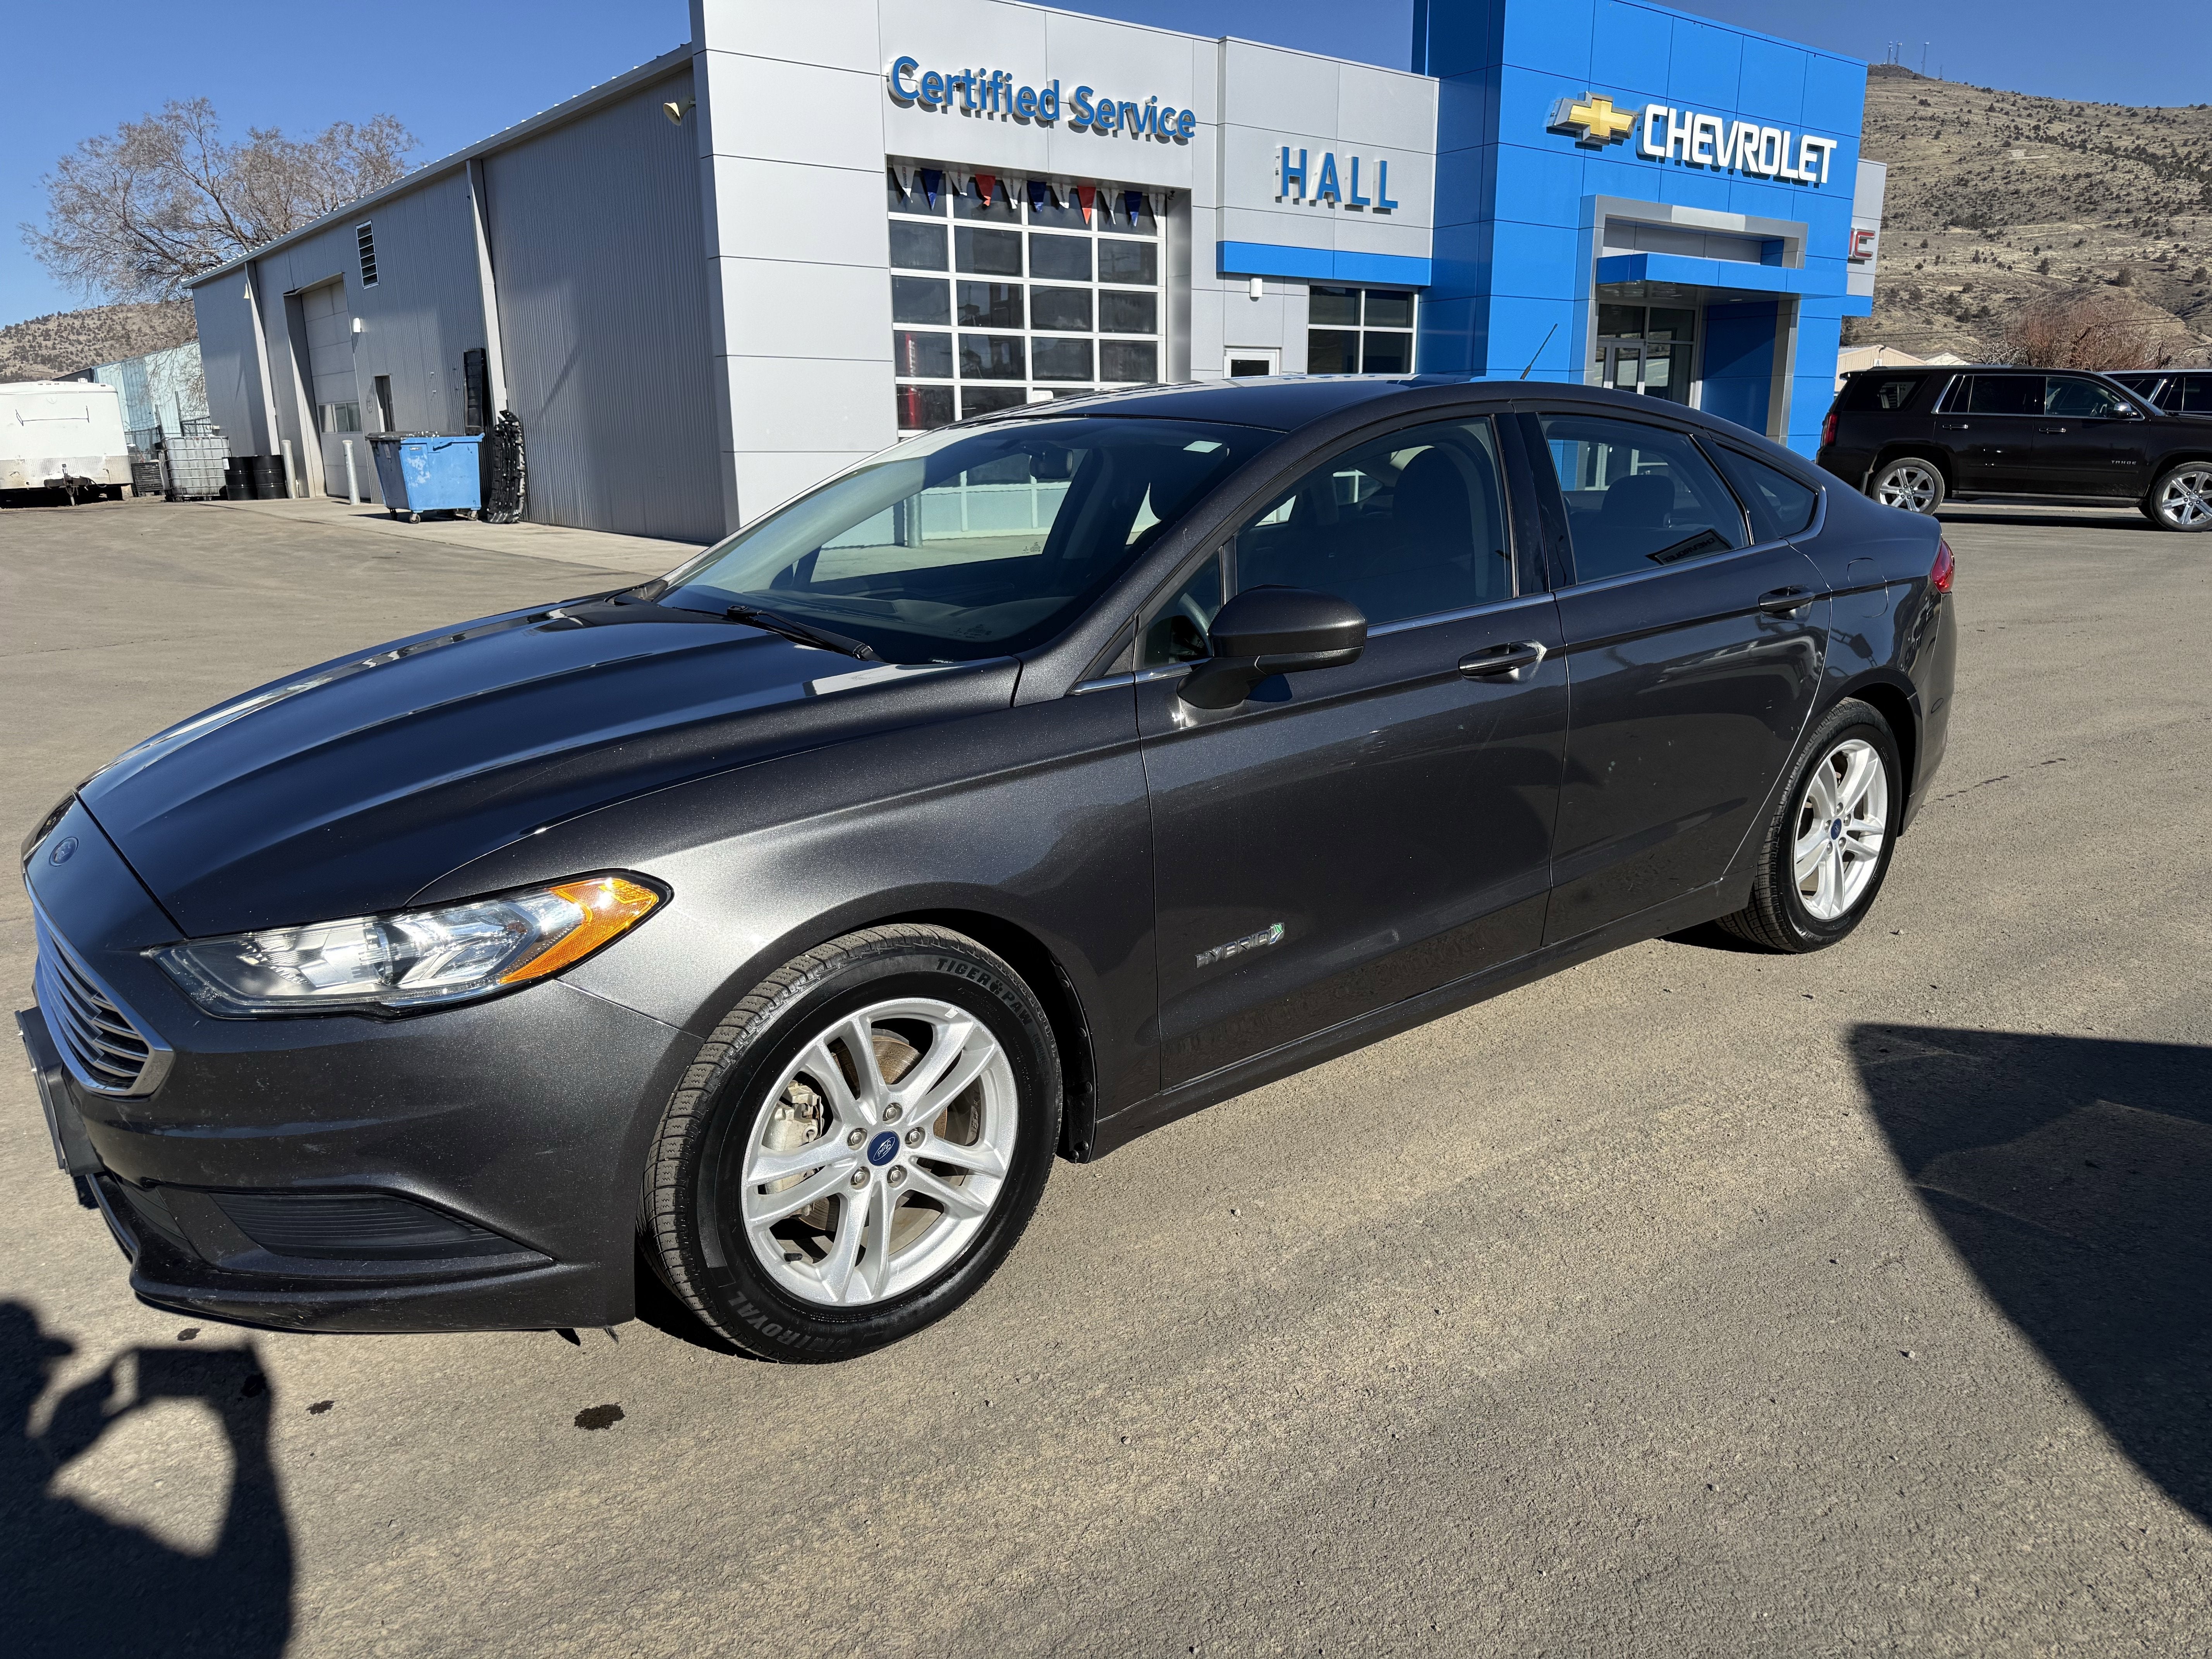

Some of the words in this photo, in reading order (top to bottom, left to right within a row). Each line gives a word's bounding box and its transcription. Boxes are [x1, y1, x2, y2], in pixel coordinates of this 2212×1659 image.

[892, 56, 1060, 121] Certified
[1075, 86, 1196, 138] Service
[1643, 104, 1837, 184] CHEVROLET
[1282, 146, 1398, 209] HALL
[1194, 930, 1271, 968] HYBRID
[936, 958, 991, 986] TIGER
[1001, 991, 1033, 1025] PAW
[877, 1140, 891, 1157] Ford
[728, 1291, 852, 1352] UNIROYAL
